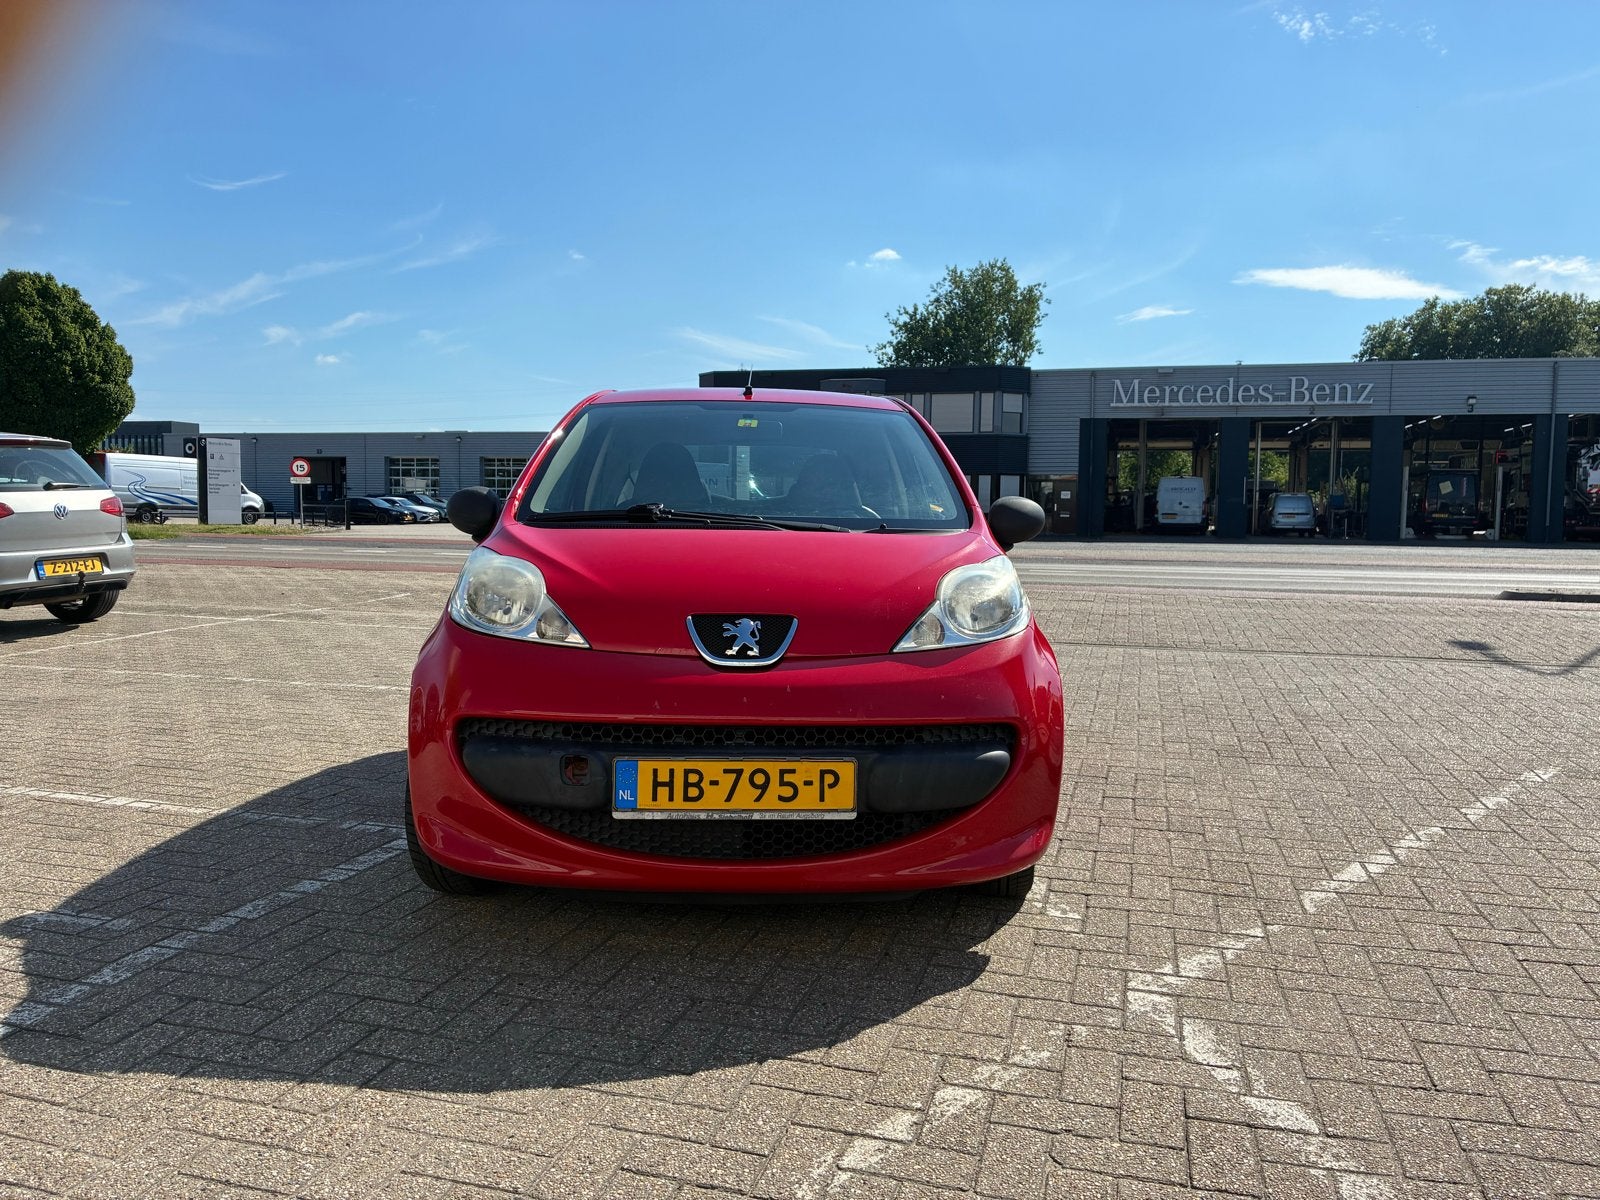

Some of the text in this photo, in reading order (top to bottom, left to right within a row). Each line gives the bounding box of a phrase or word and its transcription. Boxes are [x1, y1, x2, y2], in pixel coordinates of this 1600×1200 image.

[1111, 376, 1375, 406] Mercedes-Benz
[1467, 404, 1474, 413] 3
[295, 464, 306, 472] 15
[51, 559, 96, 574] Z-212-FJ
[651, 767, 841, 803] HB-795-P
[618, 790, 635, 801] NL
